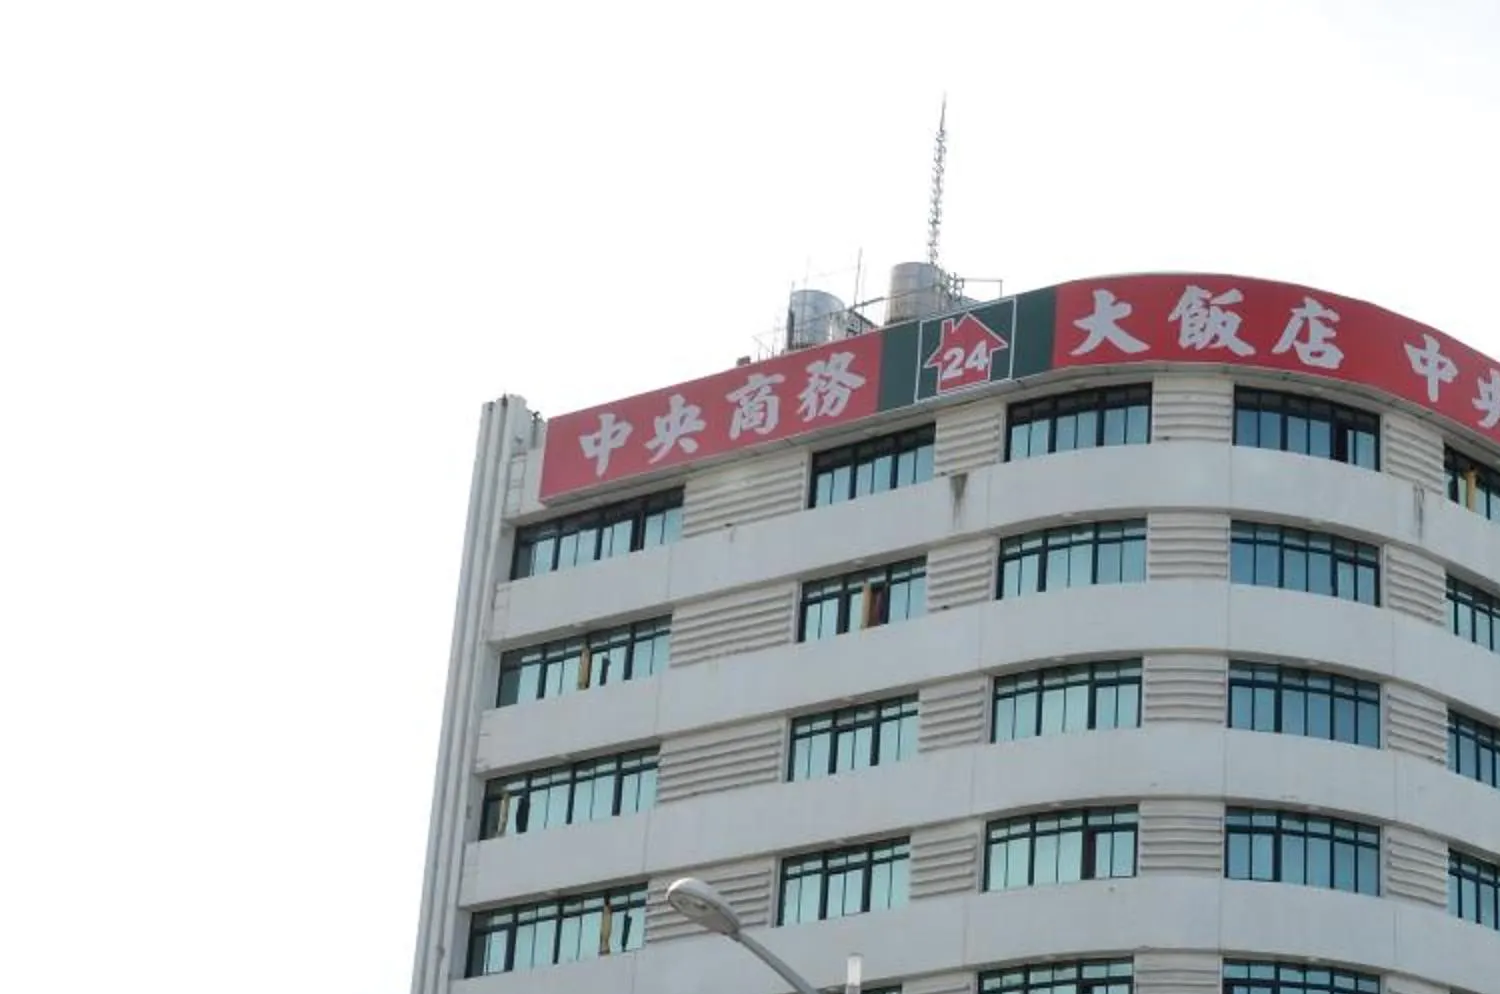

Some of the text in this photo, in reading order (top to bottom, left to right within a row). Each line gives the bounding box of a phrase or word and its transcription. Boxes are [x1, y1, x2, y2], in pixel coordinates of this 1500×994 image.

[579, 285, 1345, 476] 中央商務 24 大飯店
